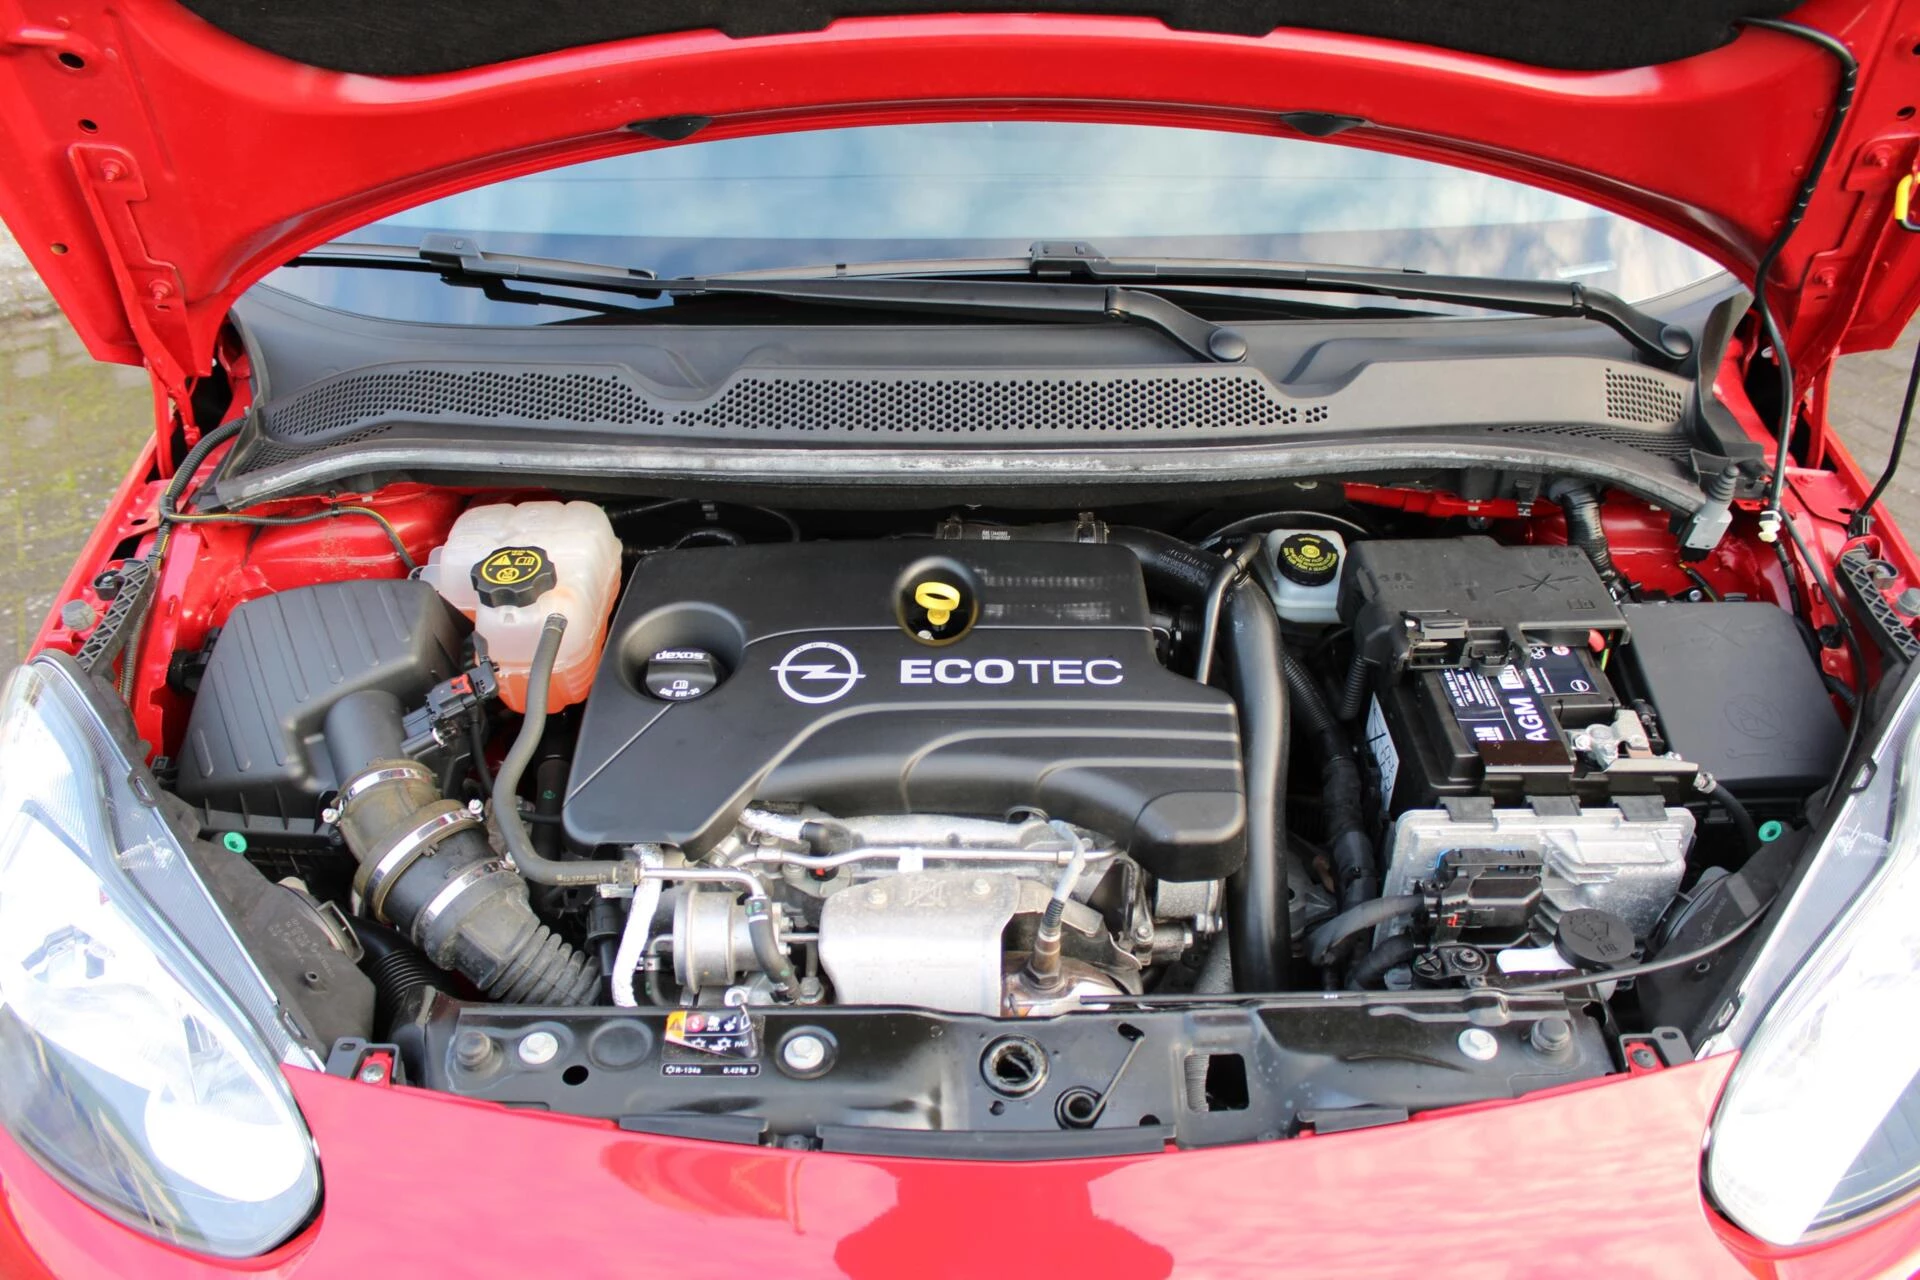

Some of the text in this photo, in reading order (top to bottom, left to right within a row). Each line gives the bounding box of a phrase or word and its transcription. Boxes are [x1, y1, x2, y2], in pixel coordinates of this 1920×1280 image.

[655, 650, 706, 660] dexos
[900, 659, 1124, 685] ECOTEC
[1508, 697, 1551, 741] AGM
